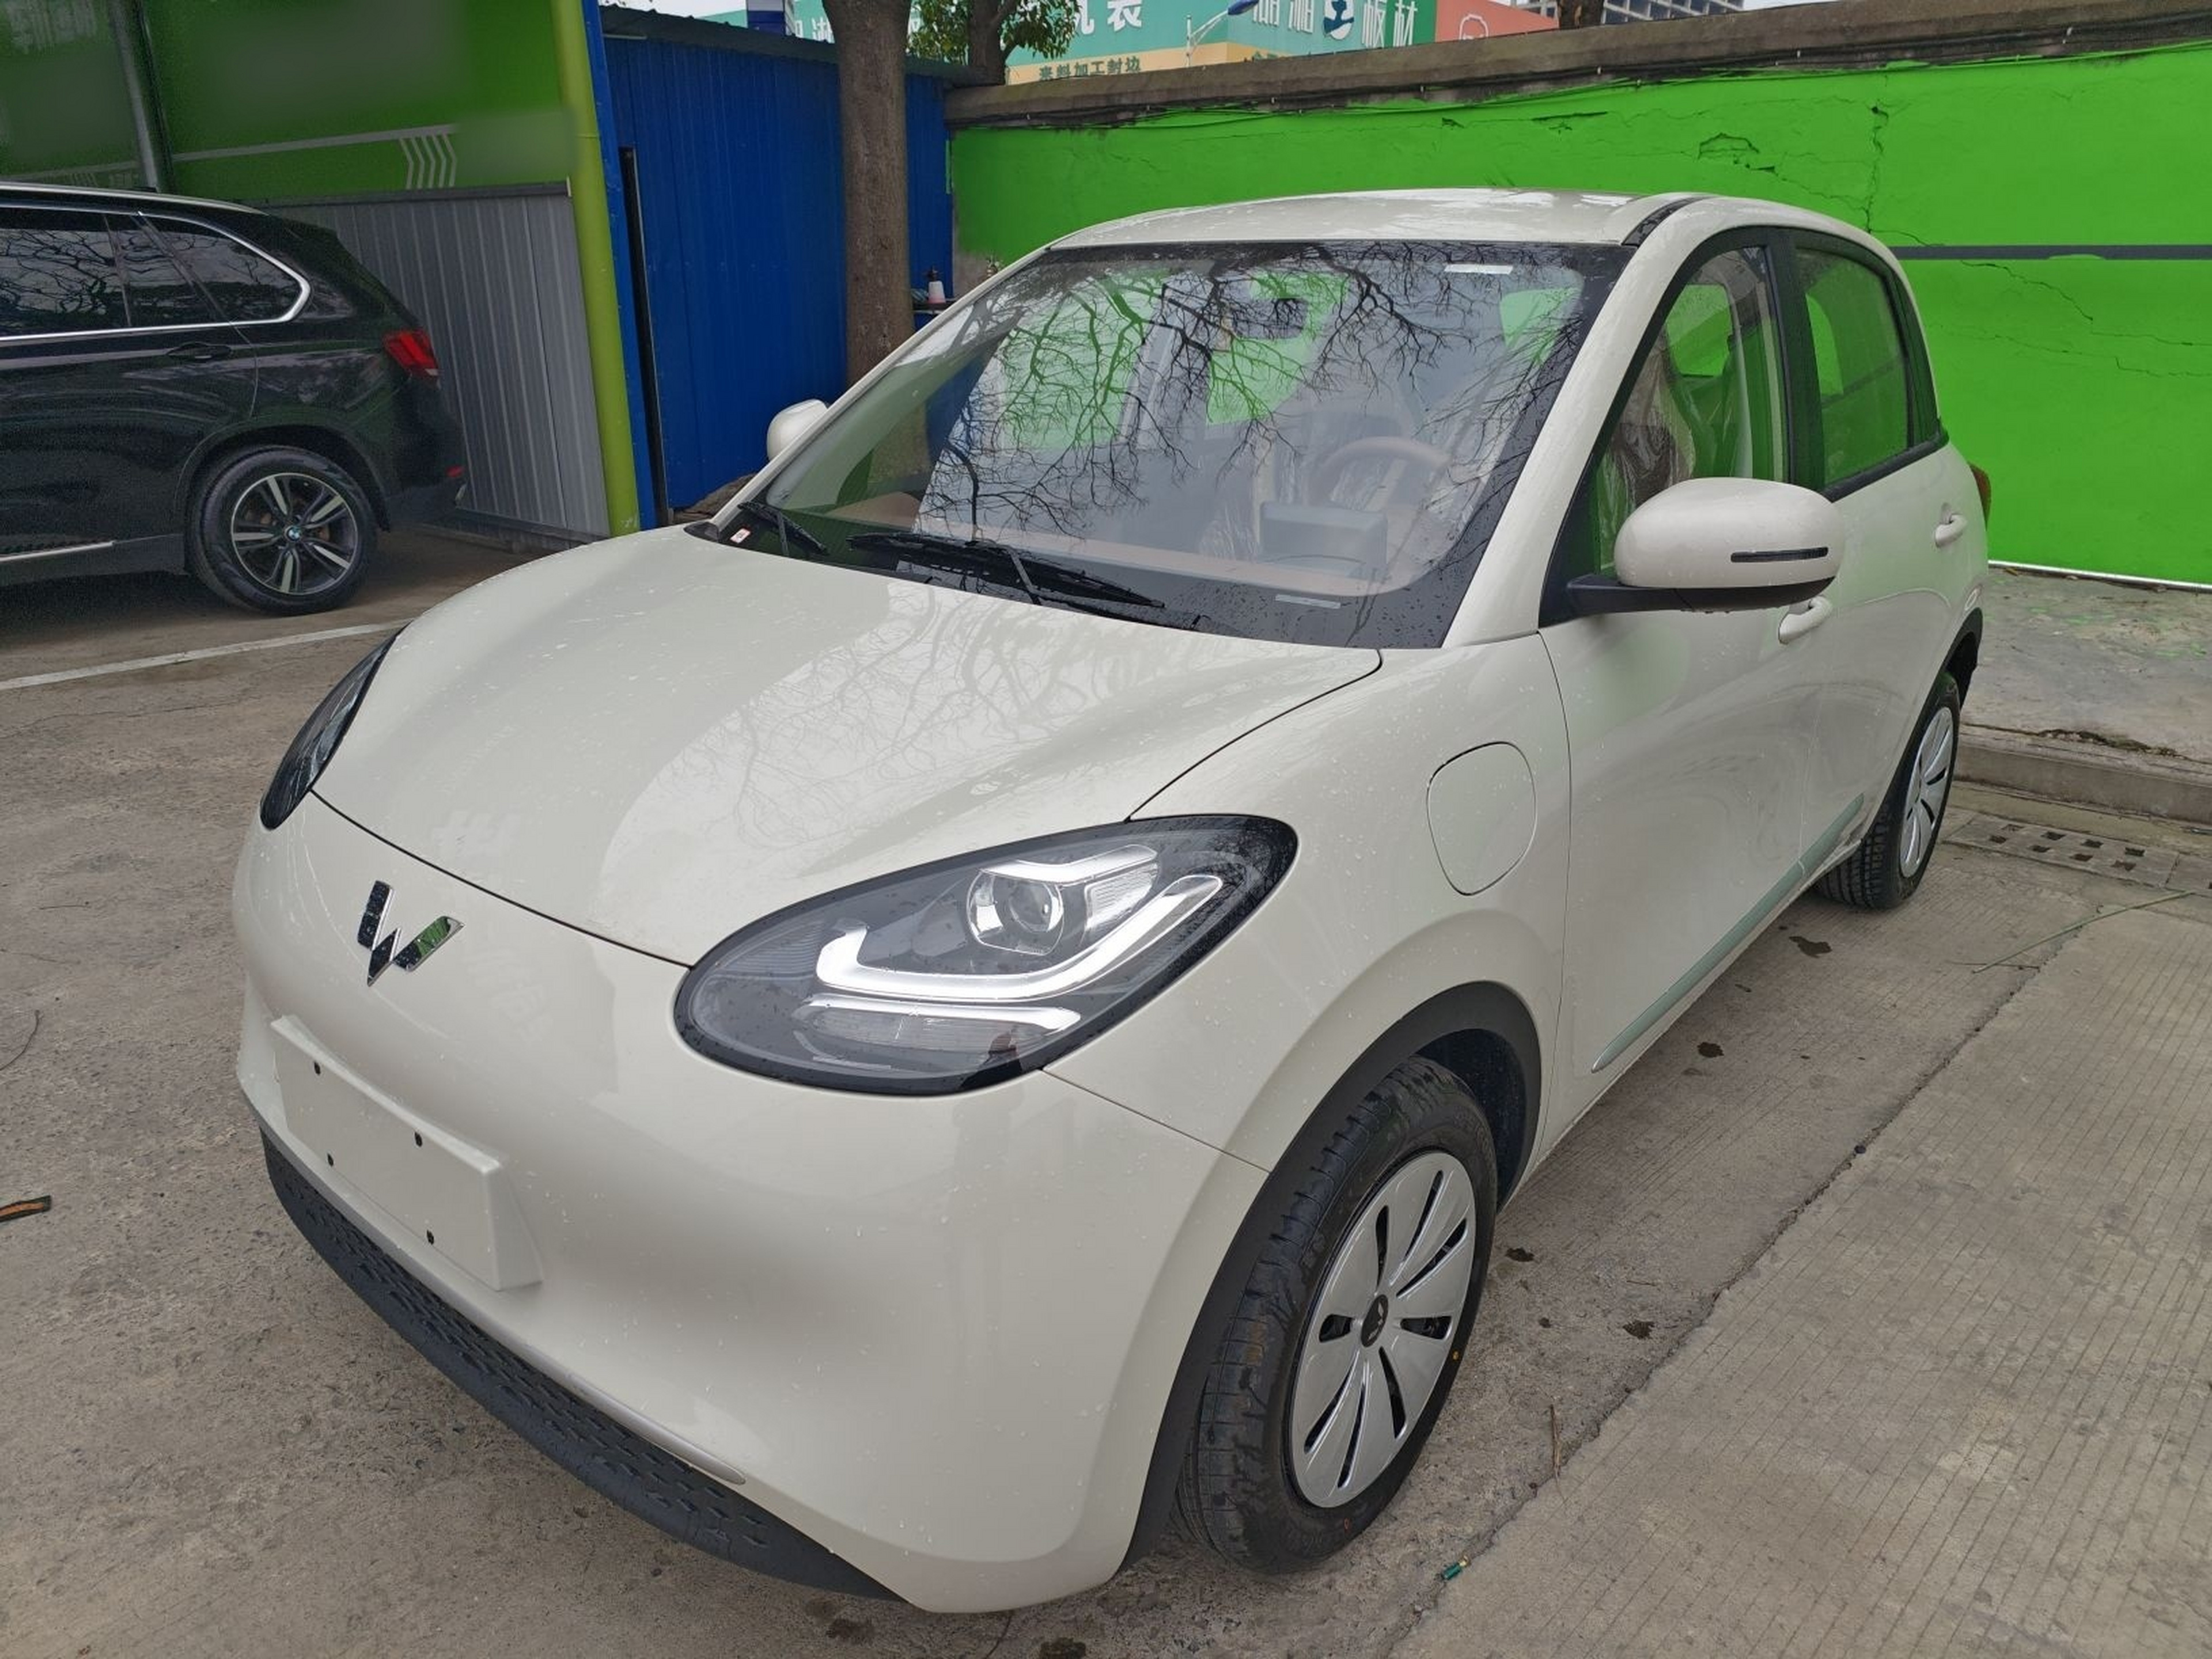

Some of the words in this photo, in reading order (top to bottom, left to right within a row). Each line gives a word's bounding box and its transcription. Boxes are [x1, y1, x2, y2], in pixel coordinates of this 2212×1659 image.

[1039, 56, 1141, 81] 来料加工封边
